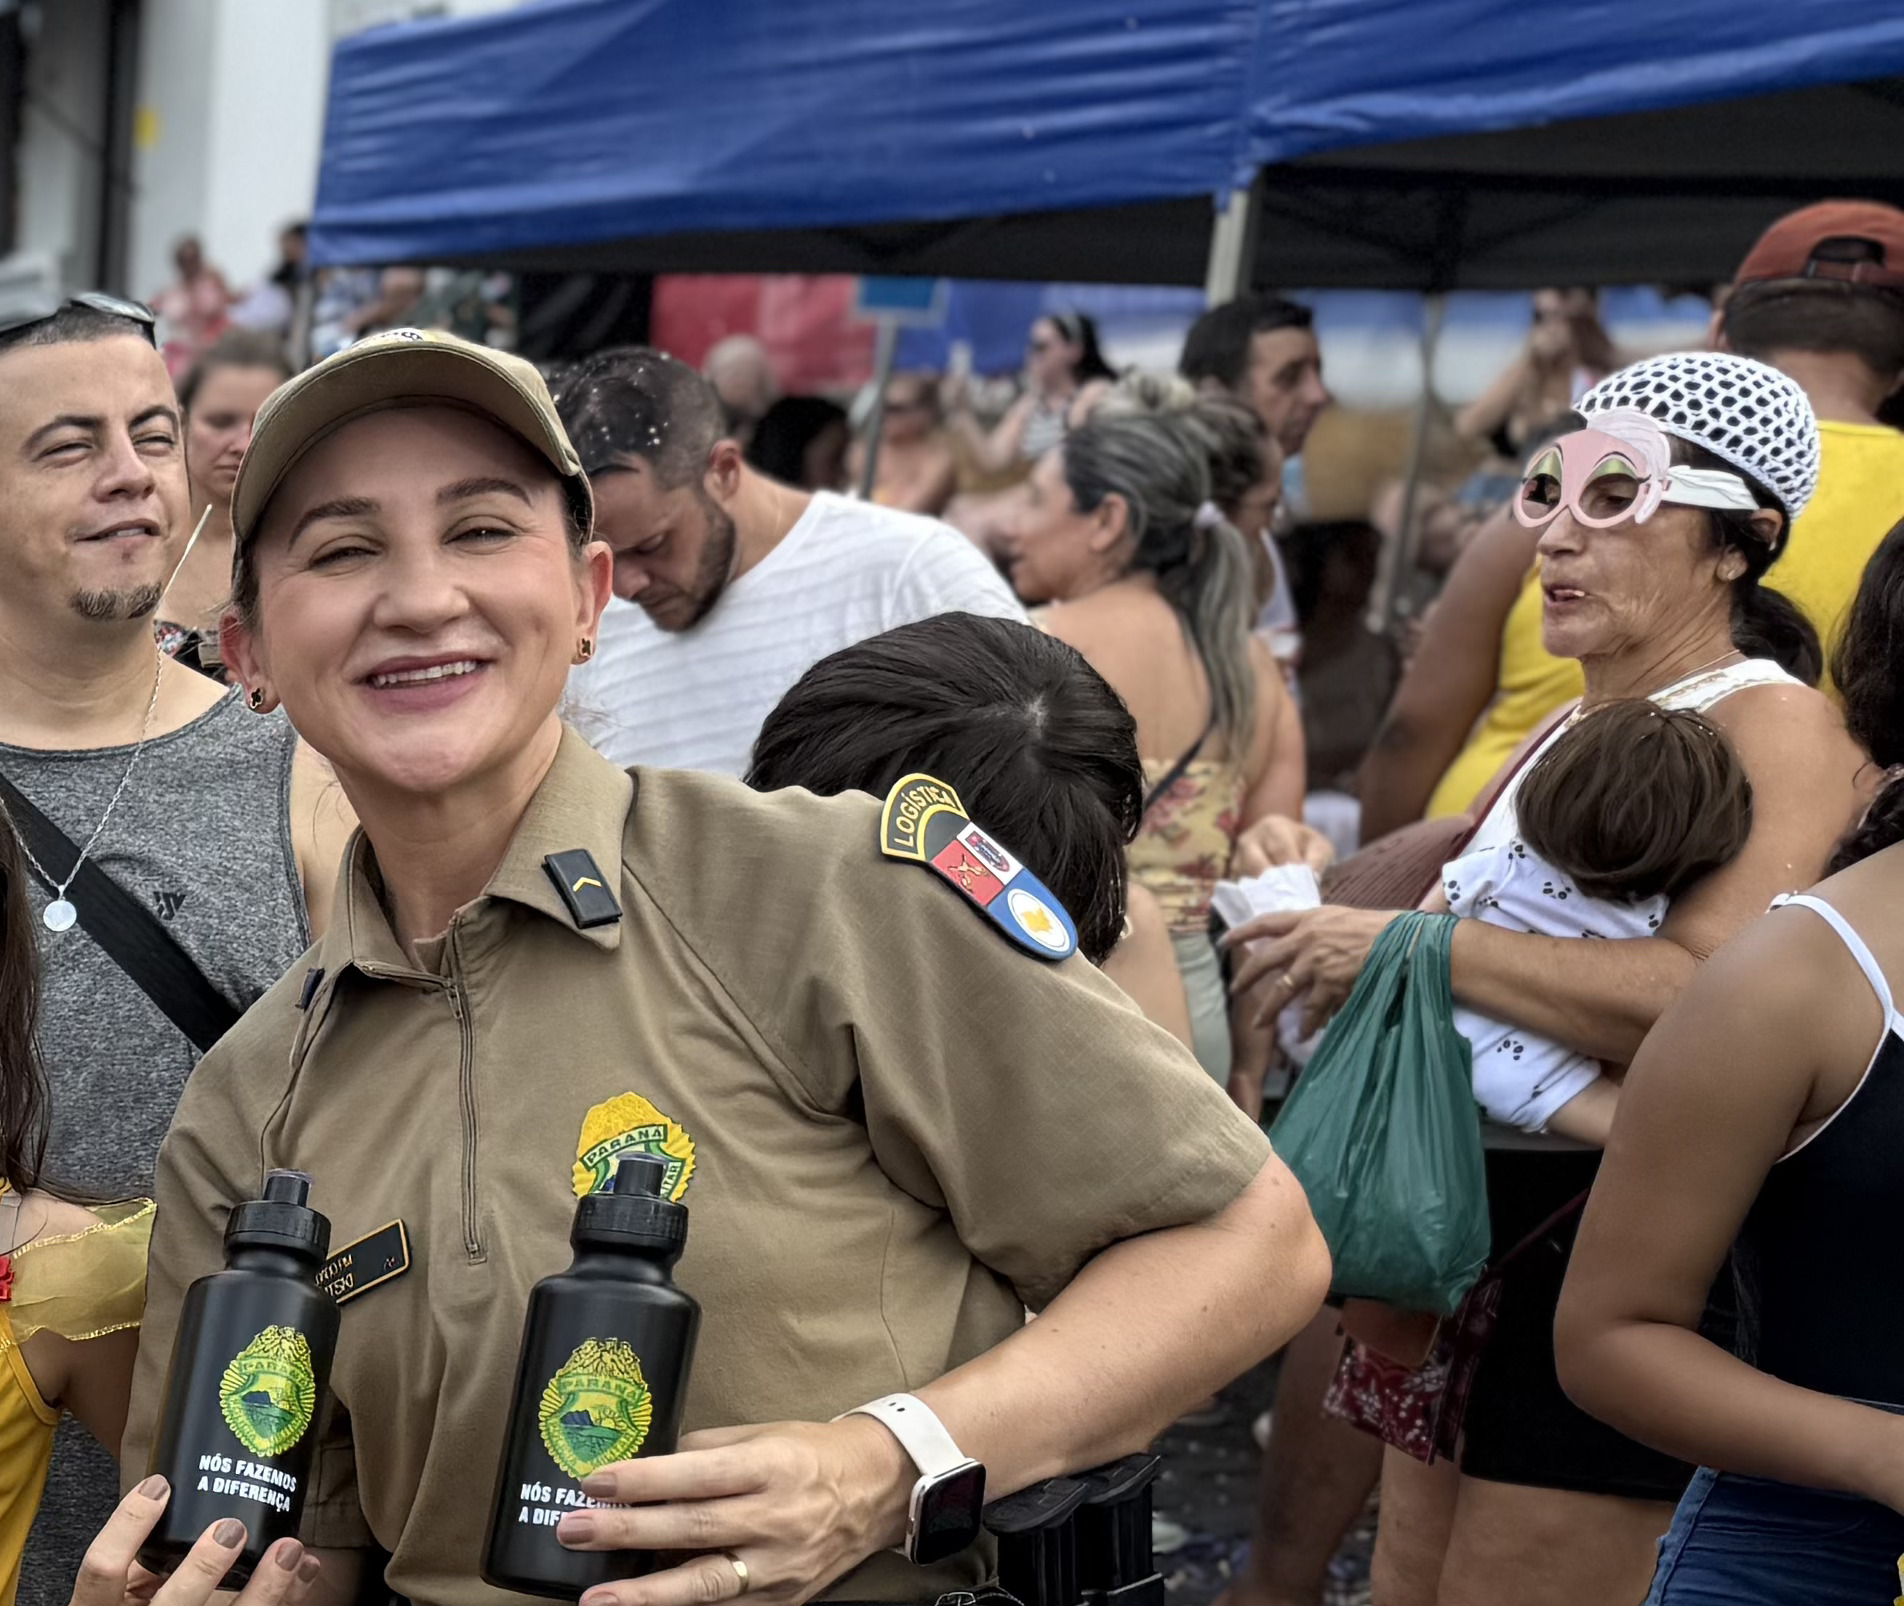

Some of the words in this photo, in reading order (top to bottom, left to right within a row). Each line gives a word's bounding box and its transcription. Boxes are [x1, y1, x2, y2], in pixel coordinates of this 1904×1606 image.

[894, 785, 956, 848] LOGÍSTICA
[585, 1126, 664, 1167] PARANÁ
[199, 1453, 232, 1473] NÓS
[235, 1460, 298, 1493] FAZEMOS
[520, 1481, 552, 1502] NÓS
[197, 1476, 209, 1492] A
[213, 1477, 291, 1513] DIFERENÇA
[519, 1506, 529, 1523] A
